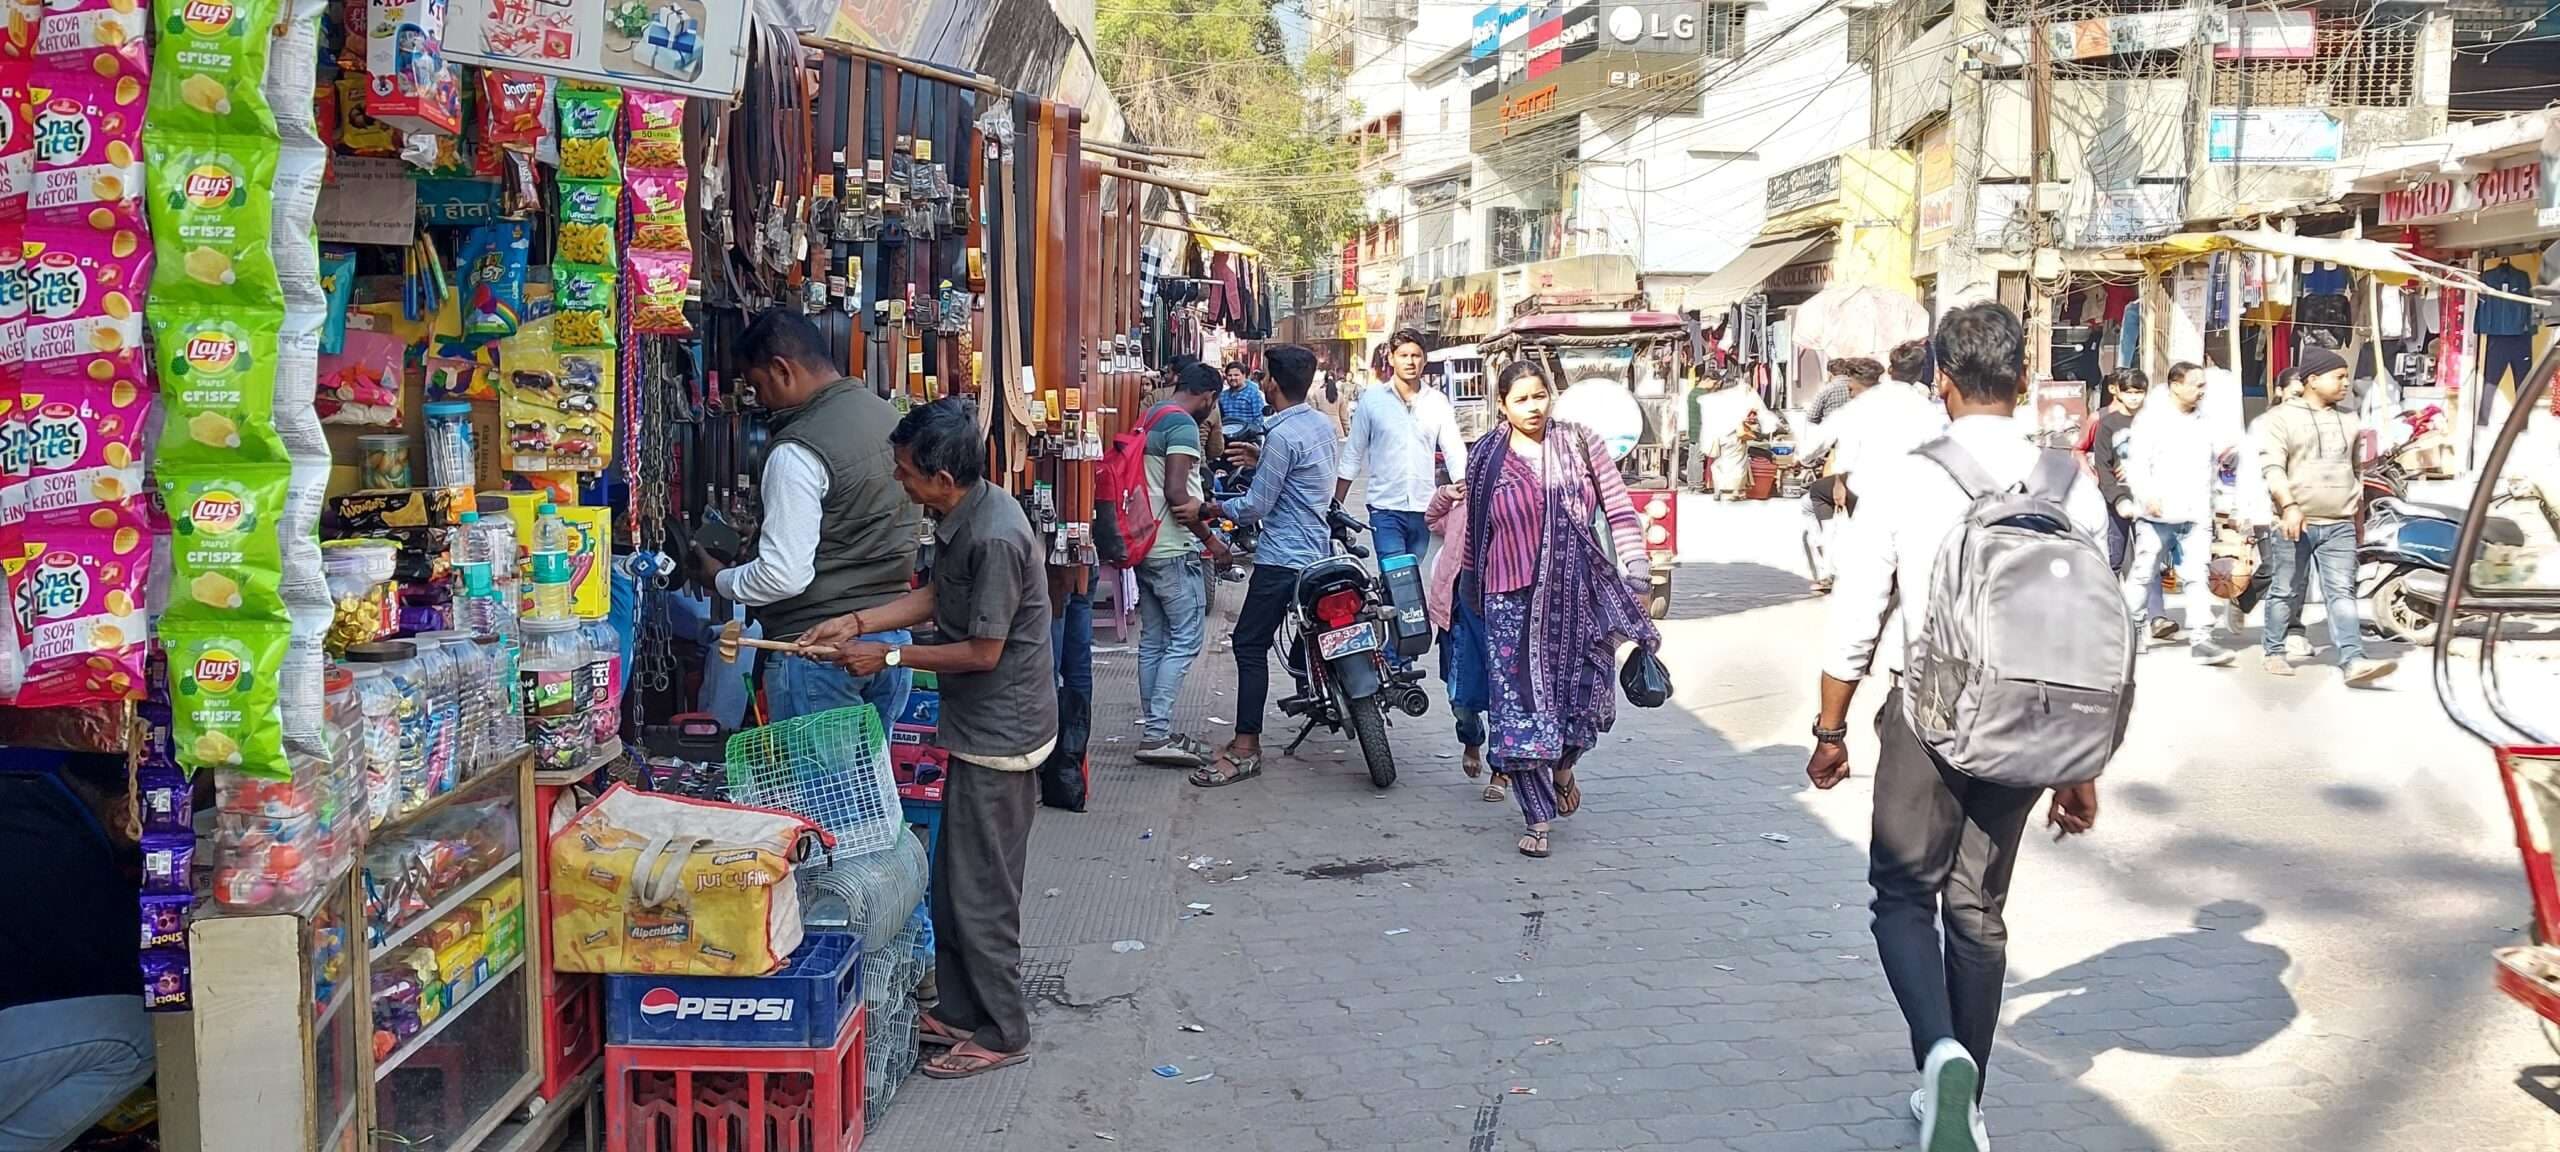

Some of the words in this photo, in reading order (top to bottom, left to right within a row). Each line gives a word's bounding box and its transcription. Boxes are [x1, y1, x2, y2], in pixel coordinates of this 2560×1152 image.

[50, 16, 80, 33] SOYA
[1651, 14, 1694, 39] LG
[38, 34, 81, 52] KATORI
[34, 114, 84, 139] Snac
[37, 135, 85, 161] Lite!
[46, 171, 78, 188] SOYA
[35, 187, 78, 207] KATORI
[2384, 180, 2454, 223] WORLD
[0, 266, 28, 287] nac
[28, 267, 79, 294] Snac
[32, 288, 80, 314] Lite!
[7, 323, 25, 342] FU
[43, 323, 75, 341] SOYA
[31, 339, 76, 359] KATORI
[0, 423, 28, 450] Sn
[29, 419, 79, 445] Snac
[3, 445, 29, 475] Lit
[32, 439, 81, 467] Lite!
[44, 474, 77, 493] SOYA
[32, 490, 78, 510] KATORI
[34, 568, 81, 595] Snac
[36, 588, 83, 615] Lite!
[43, 622, 75, 641] SOYA
[676, 997, 794, 1021] PEPSI
